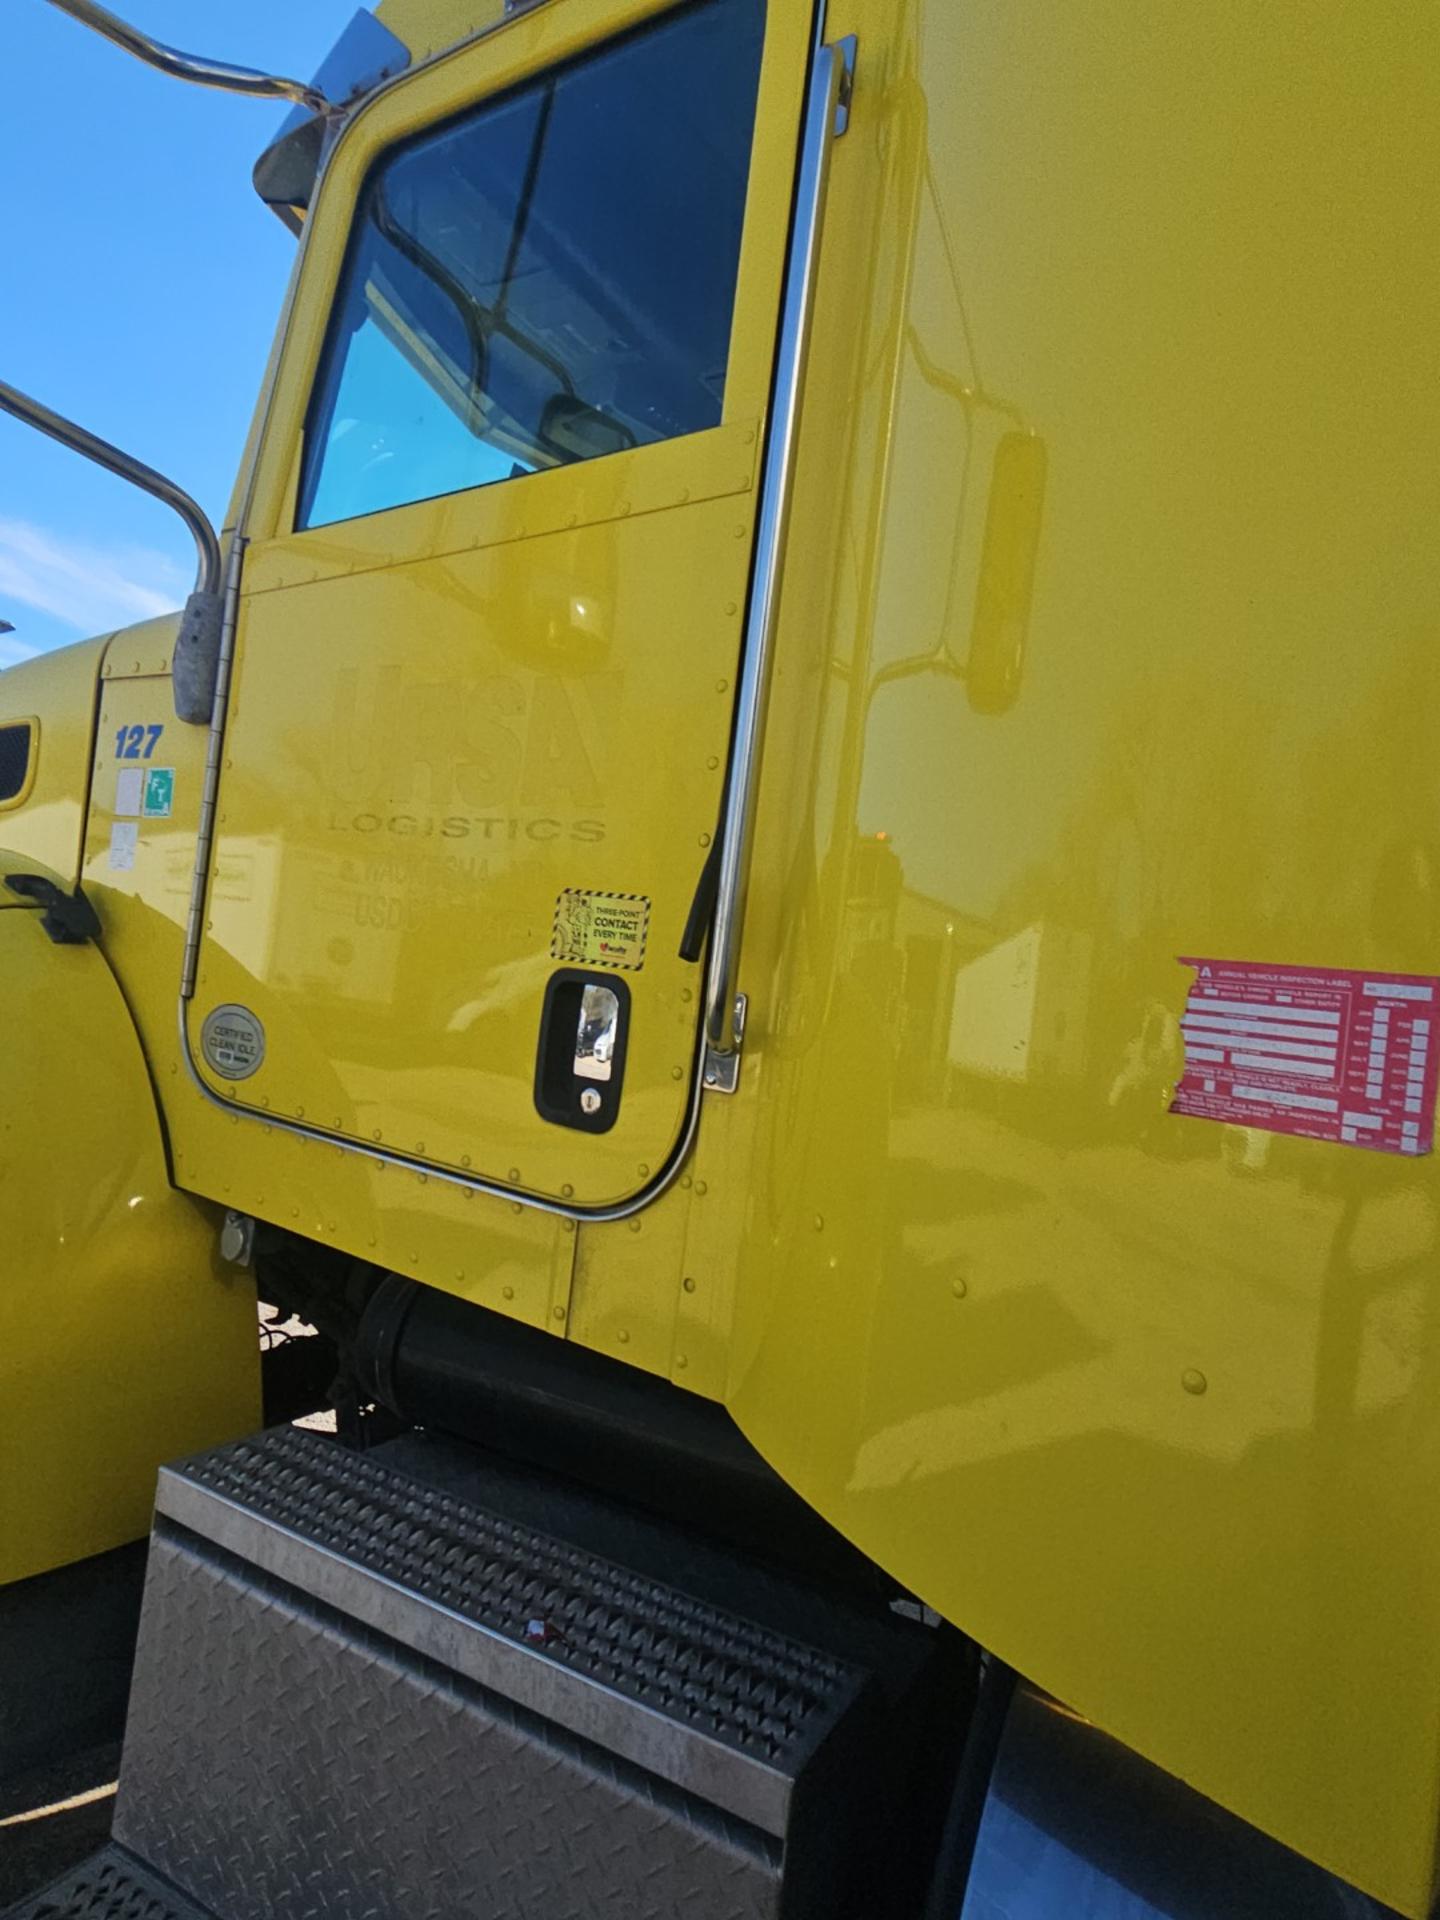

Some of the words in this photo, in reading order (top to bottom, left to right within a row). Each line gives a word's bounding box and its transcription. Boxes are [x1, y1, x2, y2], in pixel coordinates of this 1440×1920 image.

[115, 724, 164, 759] 127
[327, 813, 607, 843] LOGISTICS
[594, 917, 639, 931] CONTACT
[593, 929, 617, 940] EVERY
[619, 932, 638, 942] TIME
[1200, 966, 1212, 978] A
